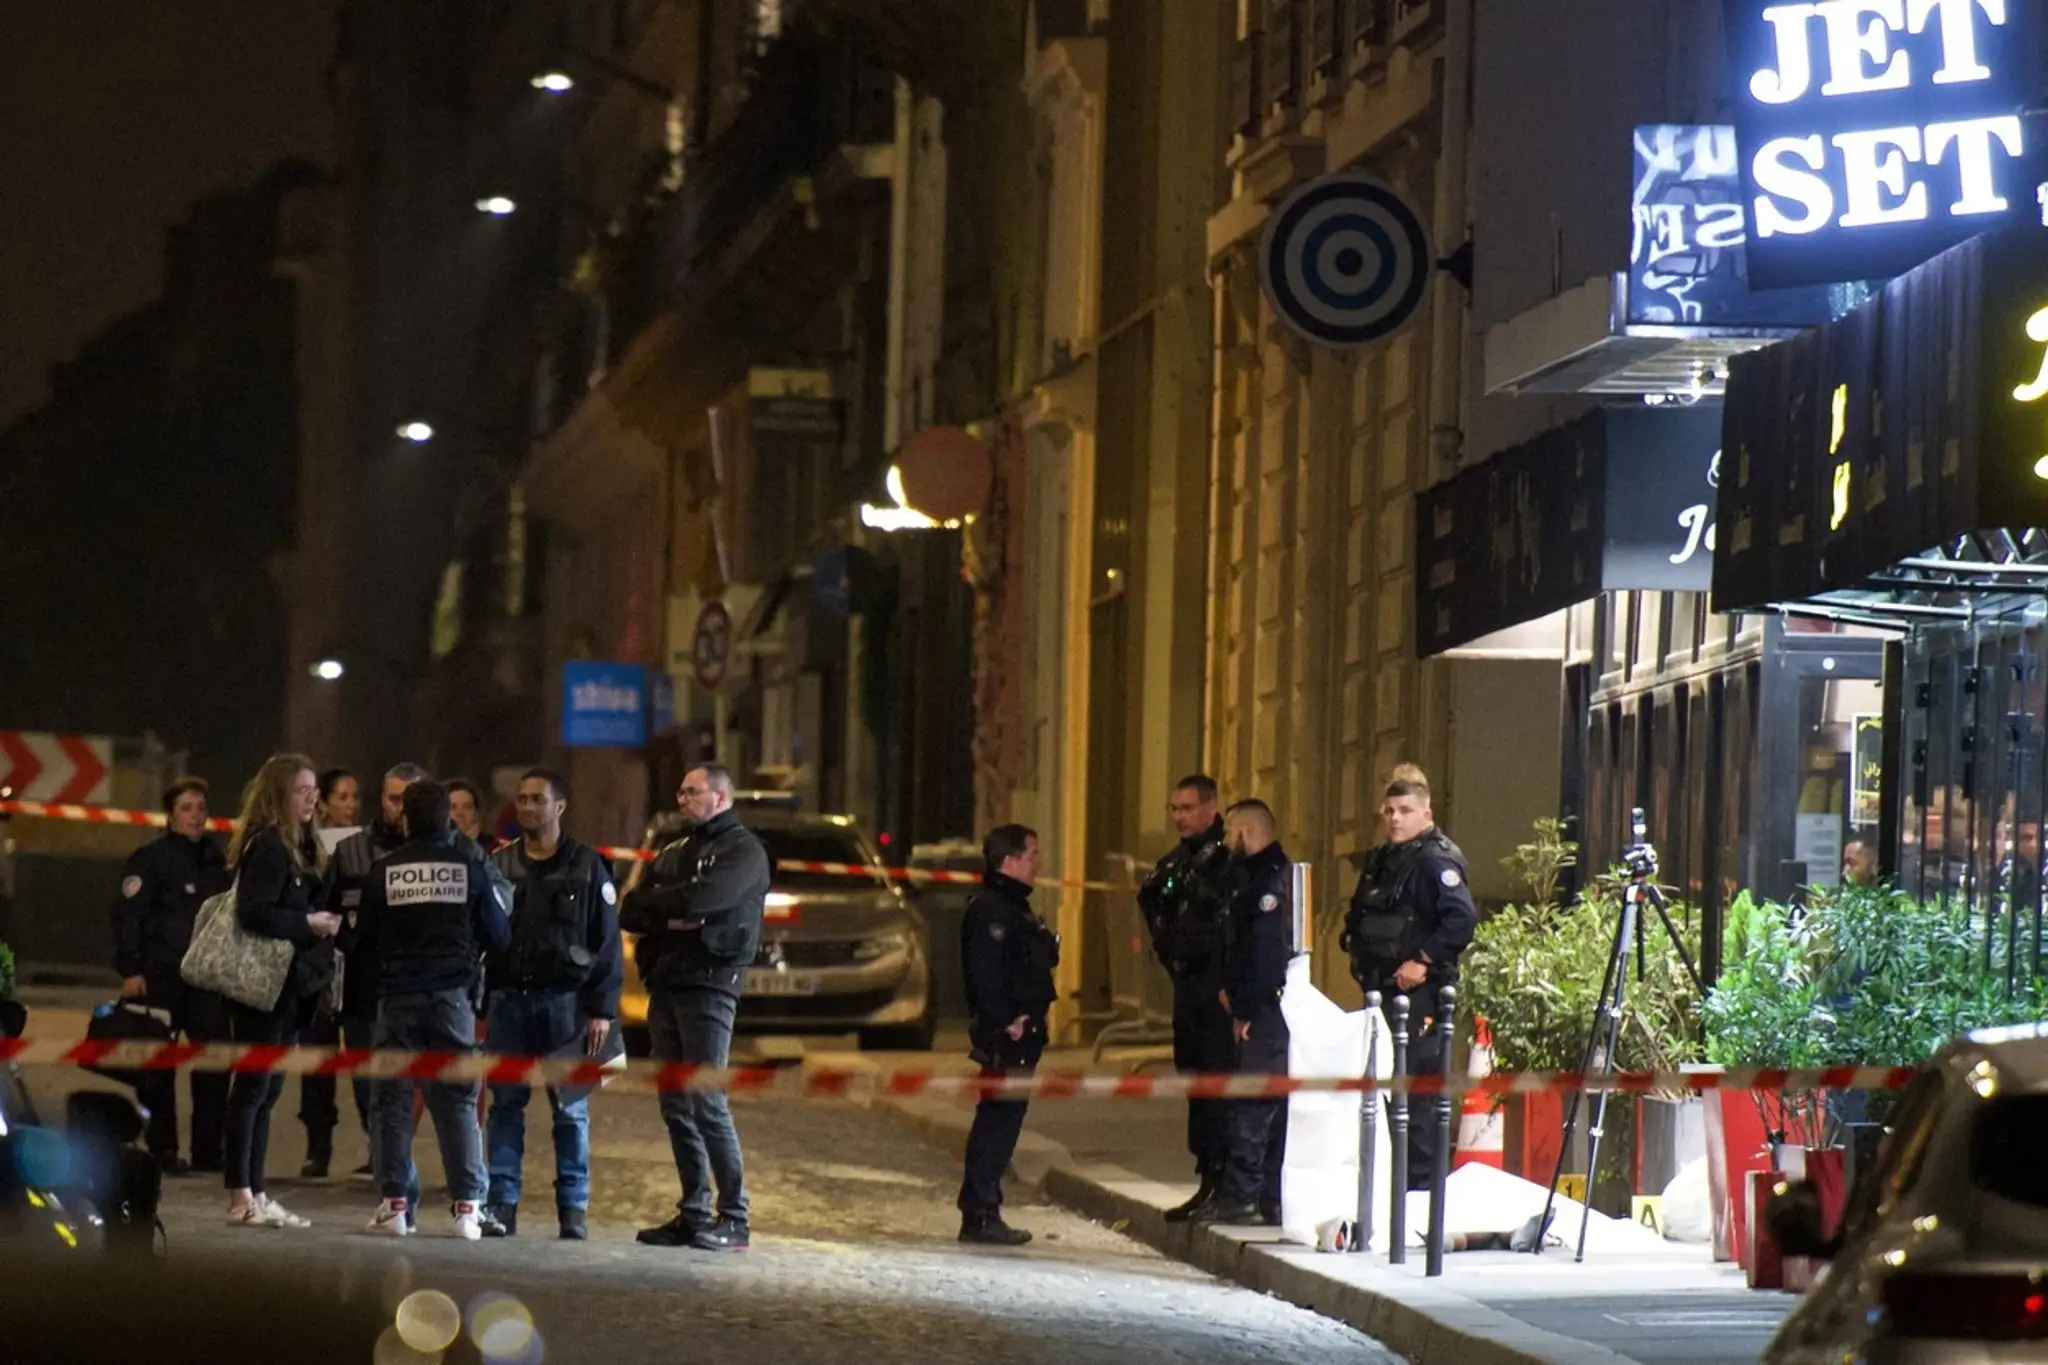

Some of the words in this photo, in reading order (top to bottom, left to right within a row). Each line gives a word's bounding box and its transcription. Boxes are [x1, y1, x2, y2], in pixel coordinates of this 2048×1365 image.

[1750, 0, 2006, 104] JET
[1751, 116, 2023, 238] SET
[389, 867, 465, 886] POLICE
[391, 886, 465, 900] JUDICIAIRE
[1640, 1203, 1660, 1236] A
